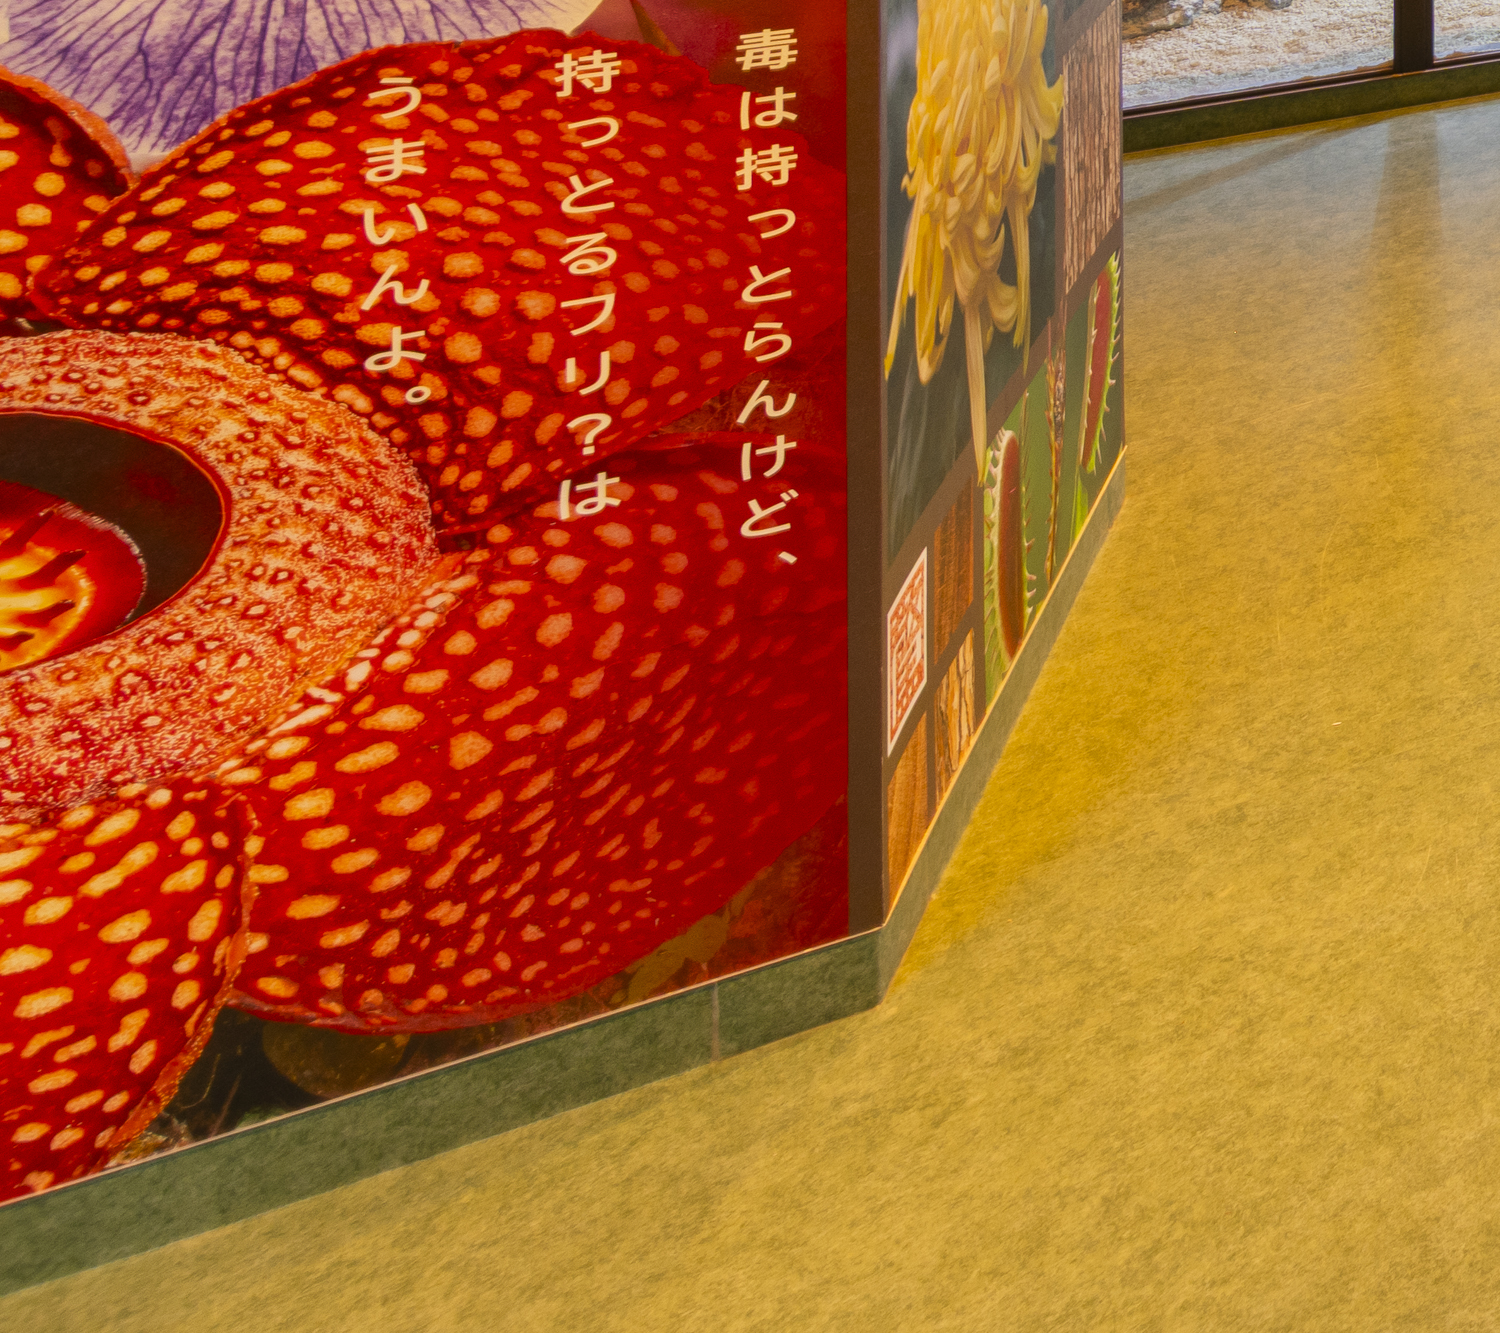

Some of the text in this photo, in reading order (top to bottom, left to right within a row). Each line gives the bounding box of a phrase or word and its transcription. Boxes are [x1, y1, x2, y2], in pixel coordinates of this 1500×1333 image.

[360, 76, 432, 403] うまいんよ。
[734, 26, 799, 566] 毒は持っとらんけど、
